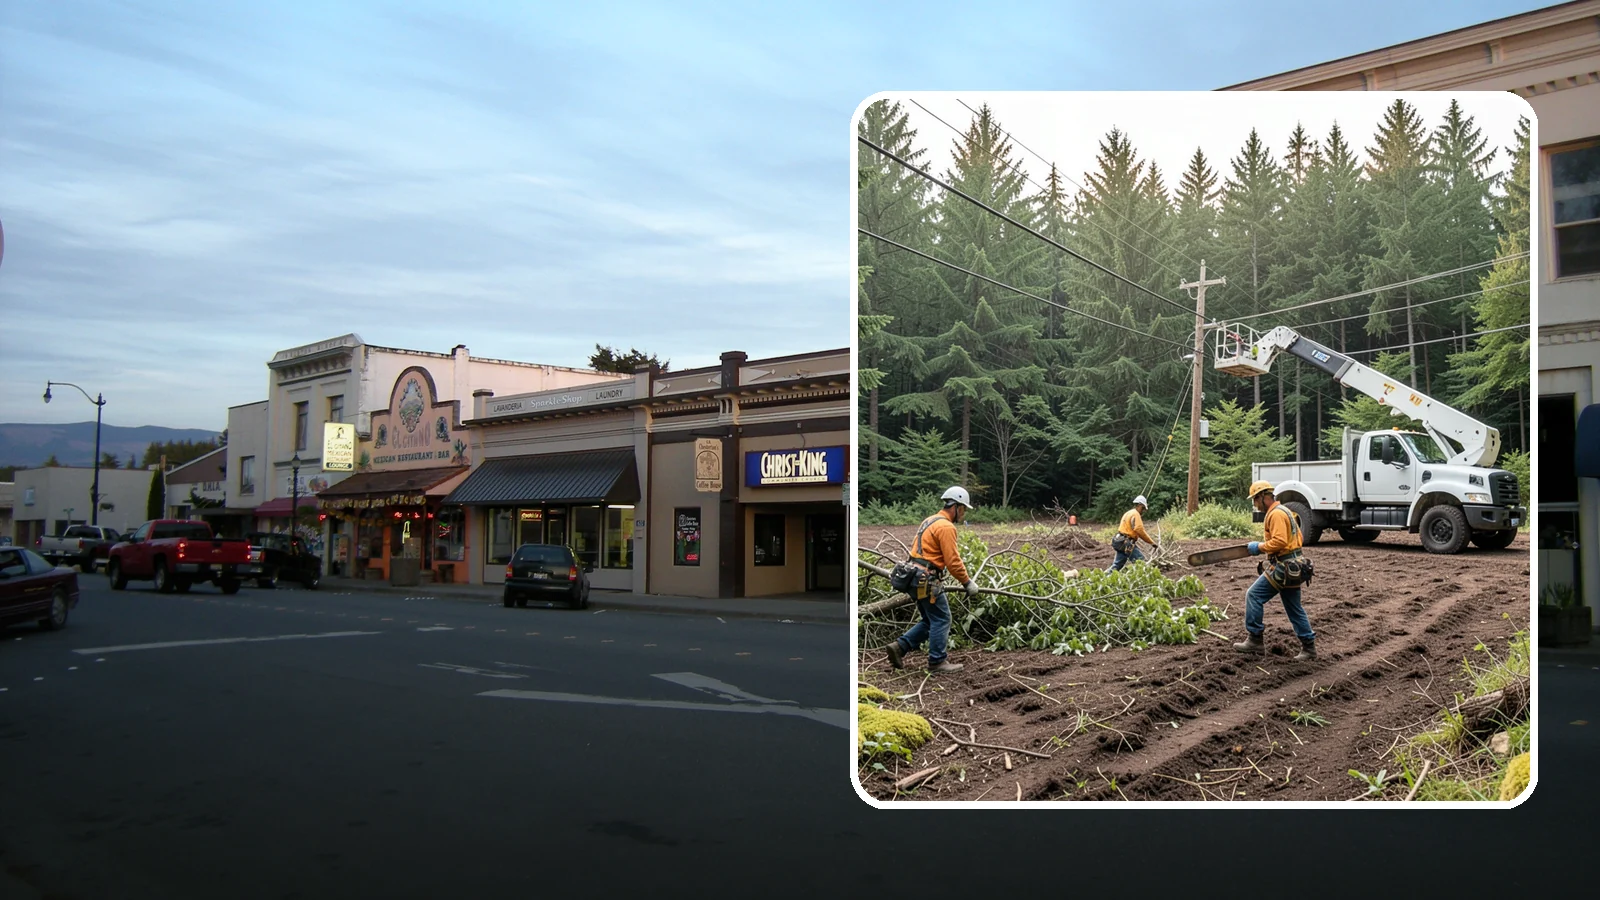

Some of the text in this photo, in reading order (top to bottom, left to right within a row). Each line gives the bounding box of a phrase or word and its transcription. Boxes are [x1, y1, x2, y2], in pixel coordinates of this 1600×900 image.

[493, 402, 522, 413] LAVANDERIA
[595, 389, 623, 400] LAUNDRY
[373, 455, 396, 465] MEXICAN
[397, 451, 433, 463] RESTAURANT
[438, 450, 450, 459] BAR
[761, 450, 827, 477] CHRIST KING
